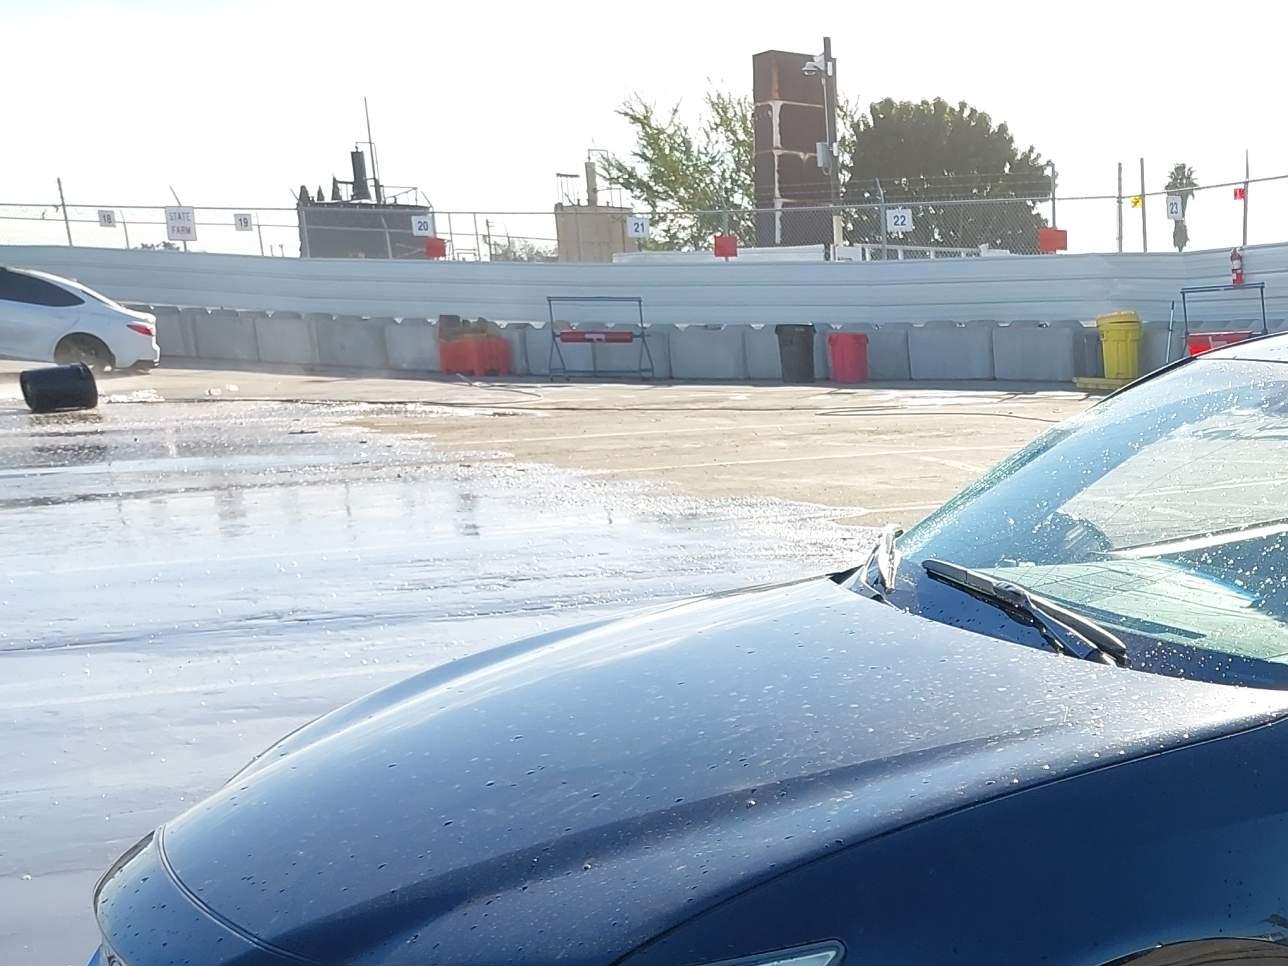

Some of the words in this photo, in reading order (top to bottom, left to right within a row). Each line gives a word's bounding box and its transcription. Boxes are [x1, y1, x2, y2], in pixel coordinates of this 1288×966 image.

[1169, 202, 1178, 214] 23
[168, 211, 191, 221] STATE
[239, 217, 249, 225] 19
[893, 214, 906, 226] 22
[171, 226, 191, 234] FARM
[417, 221, 428, 231] 20
[633, 222, 645, 233] 21
